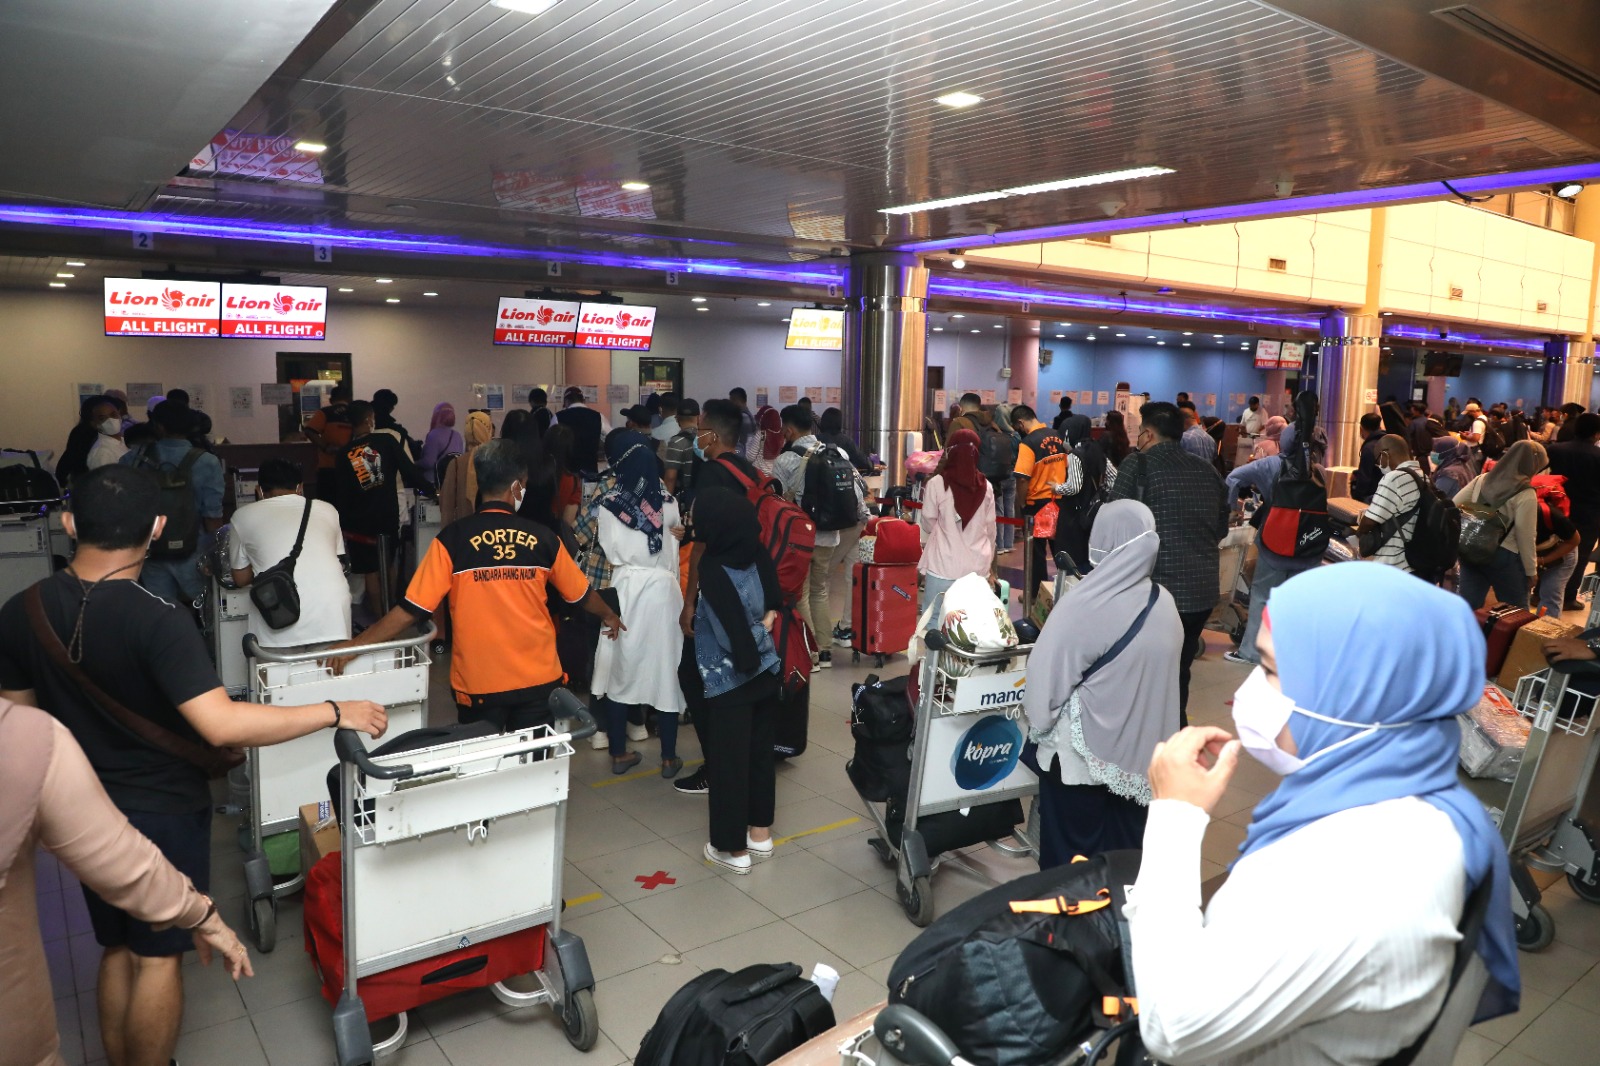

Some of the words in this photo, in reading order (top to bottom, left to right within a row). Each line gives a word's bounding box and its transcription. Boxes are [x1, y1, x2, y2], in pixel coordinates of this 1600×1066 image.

[139, 232, 148, 247] 2
[319, 246, 327, 260] 3
[551, 262, 558, 275] 4
[669, 272, 676, 284] 5
[109, 291, 159, 305] Lion
[186, 293, 216, 307] air
[226, 296, 271, 309] Lion
[295, 298, 322, 311] air
[500, 308, 535, 320] Lion
[553, 311, 576, 323] air
[581, 313, 614, 325] Lion
[631, 316, 652, 327] air
[120, 320, 150, 332] ALL
[153, 321, 207, 333] FLIGHT
[234, 323, 262, 334] ALL
[265, 324, 313, 335] FLIGHT
[792, 318, 817, 328] Lion
[504, 332, 526, 342] ALL
[528, 333, 566, 343] FLIGHT
[584, 336, 605, 345] ALL
[606, 337, 642, 347] FLIGHT
[469, 528, 538, 551] PORTER
[493, 544, 517, 560] 35
[473, 568, 502, 582] BANDARA
[502, 567, 519, 580] HANG
[964, 740, 1014, 766] kopra
